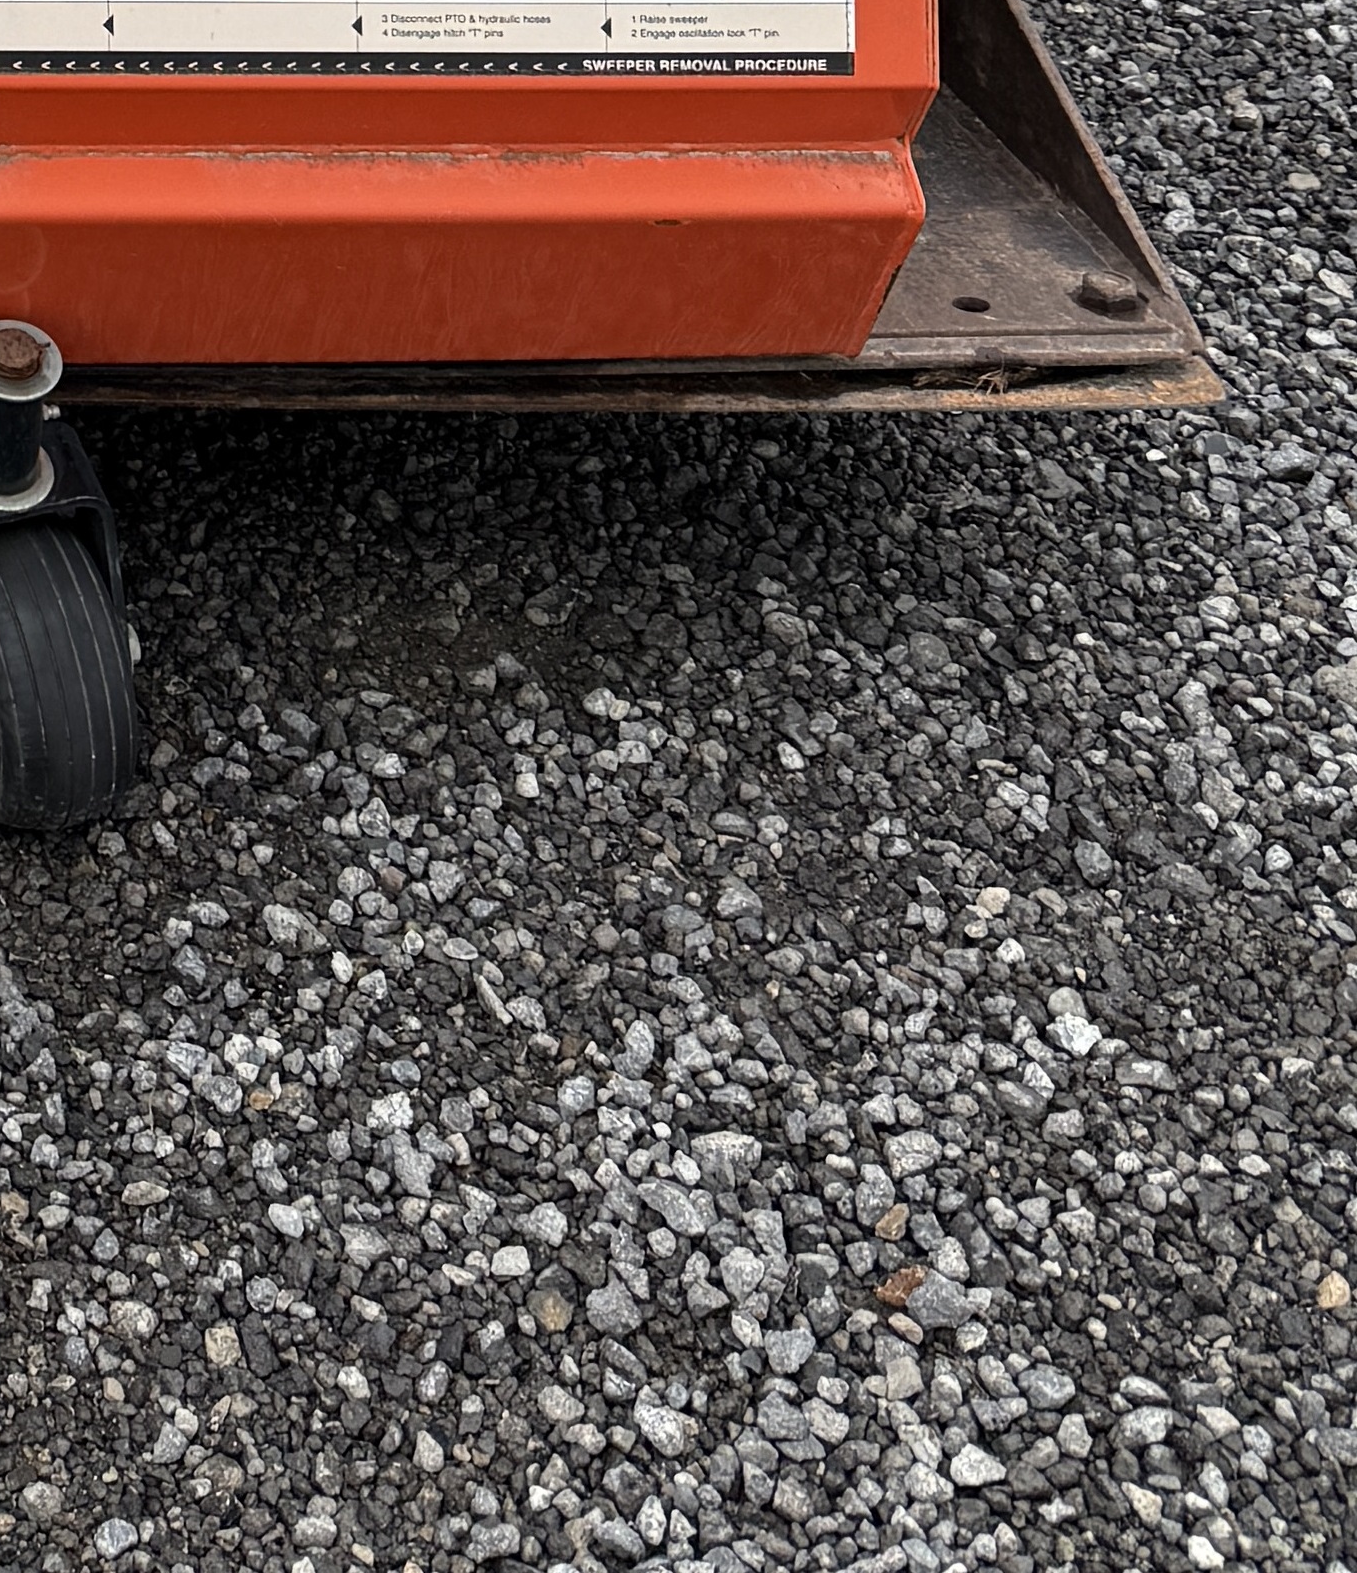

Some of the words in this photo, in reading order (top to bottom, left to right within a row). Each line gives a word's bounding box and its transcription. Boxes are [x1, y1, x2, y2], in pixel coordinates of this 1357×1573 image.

[391, 15, 442, 23] Disconnect
[445, 15, 466, 23] PTO
[469, 15, 476, 23] &
[478, 15, 520, 25] hydraulic
[523, 15, 551, 24] hoses
[640, 15, 666, 24] Raise
[391, 28, 441, 39] Disengage
[444, 29, 466, 37] hitch
[484, 30, 504, 39] pins
[631, 29, 637, 38] 2
[640, 29, 676, 39] Engage
[679, 29, 725, 38] oscillation
[582, 60, 656, 72] SWEEPER
[660, 60, 730, 72] REMOVAL
[735, 59, 827, 72] PROCEDURE
